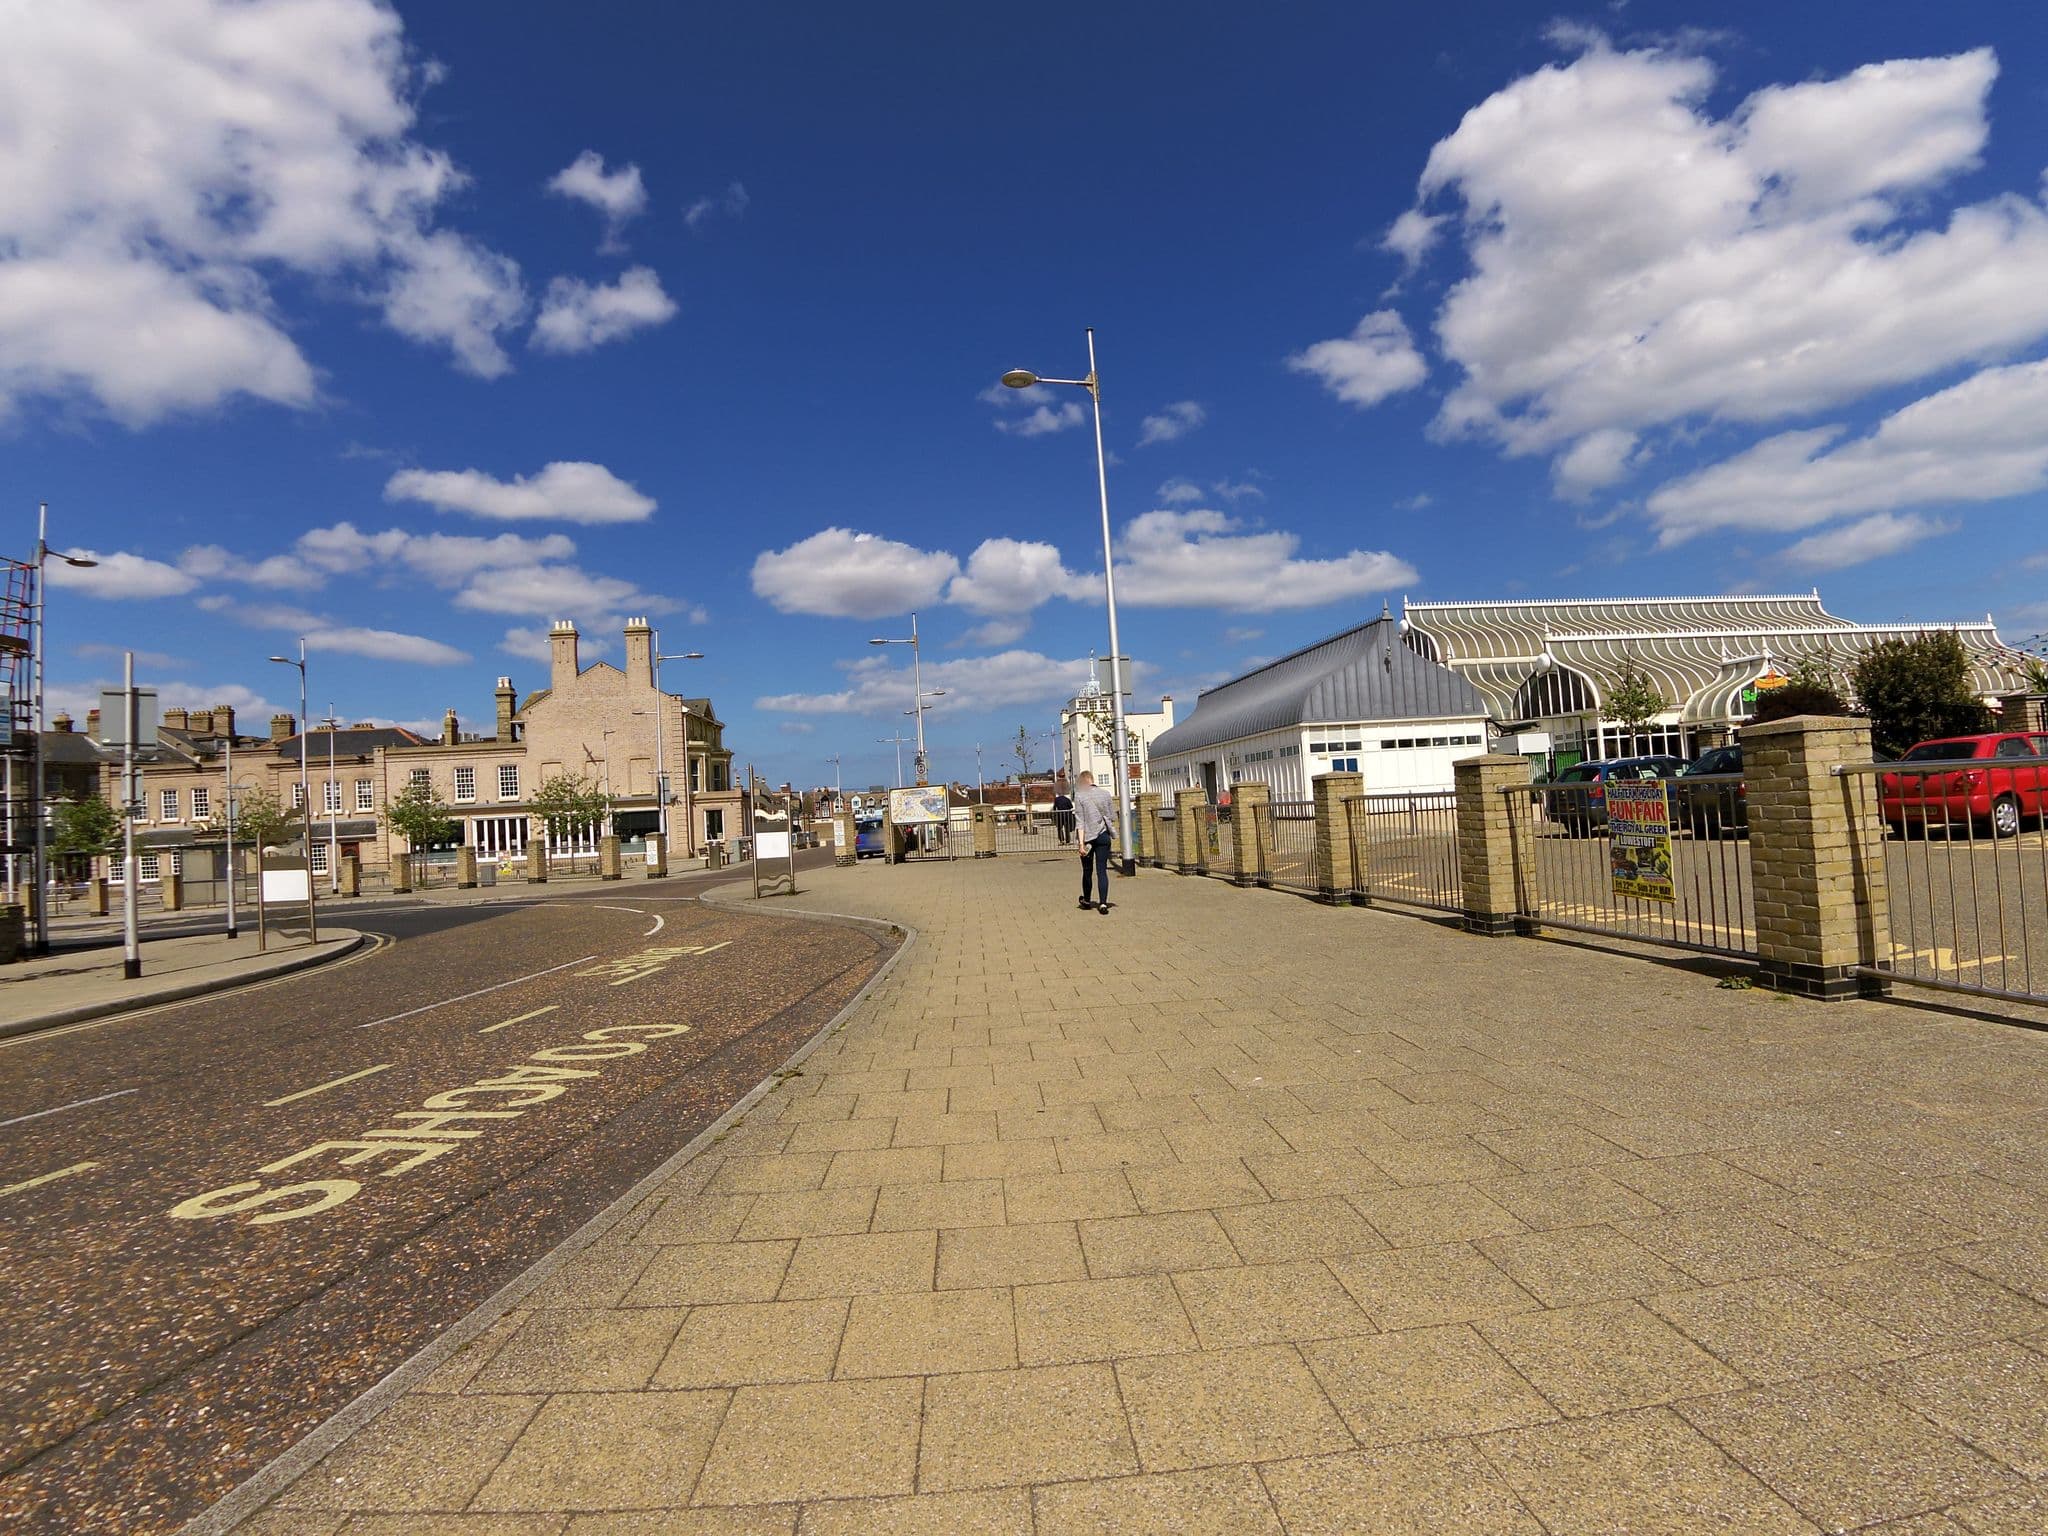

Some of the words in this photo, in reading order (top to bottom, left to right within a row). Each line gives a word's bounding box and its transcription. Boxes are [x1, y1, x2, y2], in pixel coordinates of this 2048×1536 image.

[1609, 800, 1633, 820] FUN
[1635, 801, 1666, 821] FAIR
[1610, 822, 1622, 832] THE
[1622, 823, 1643, 833] ROYAL
[1644, 825, 1667, 835] GREEN
[1620, 835, 1655, 847] LOWESTOFT
[170, 1023, 691, 1224] COACHES
